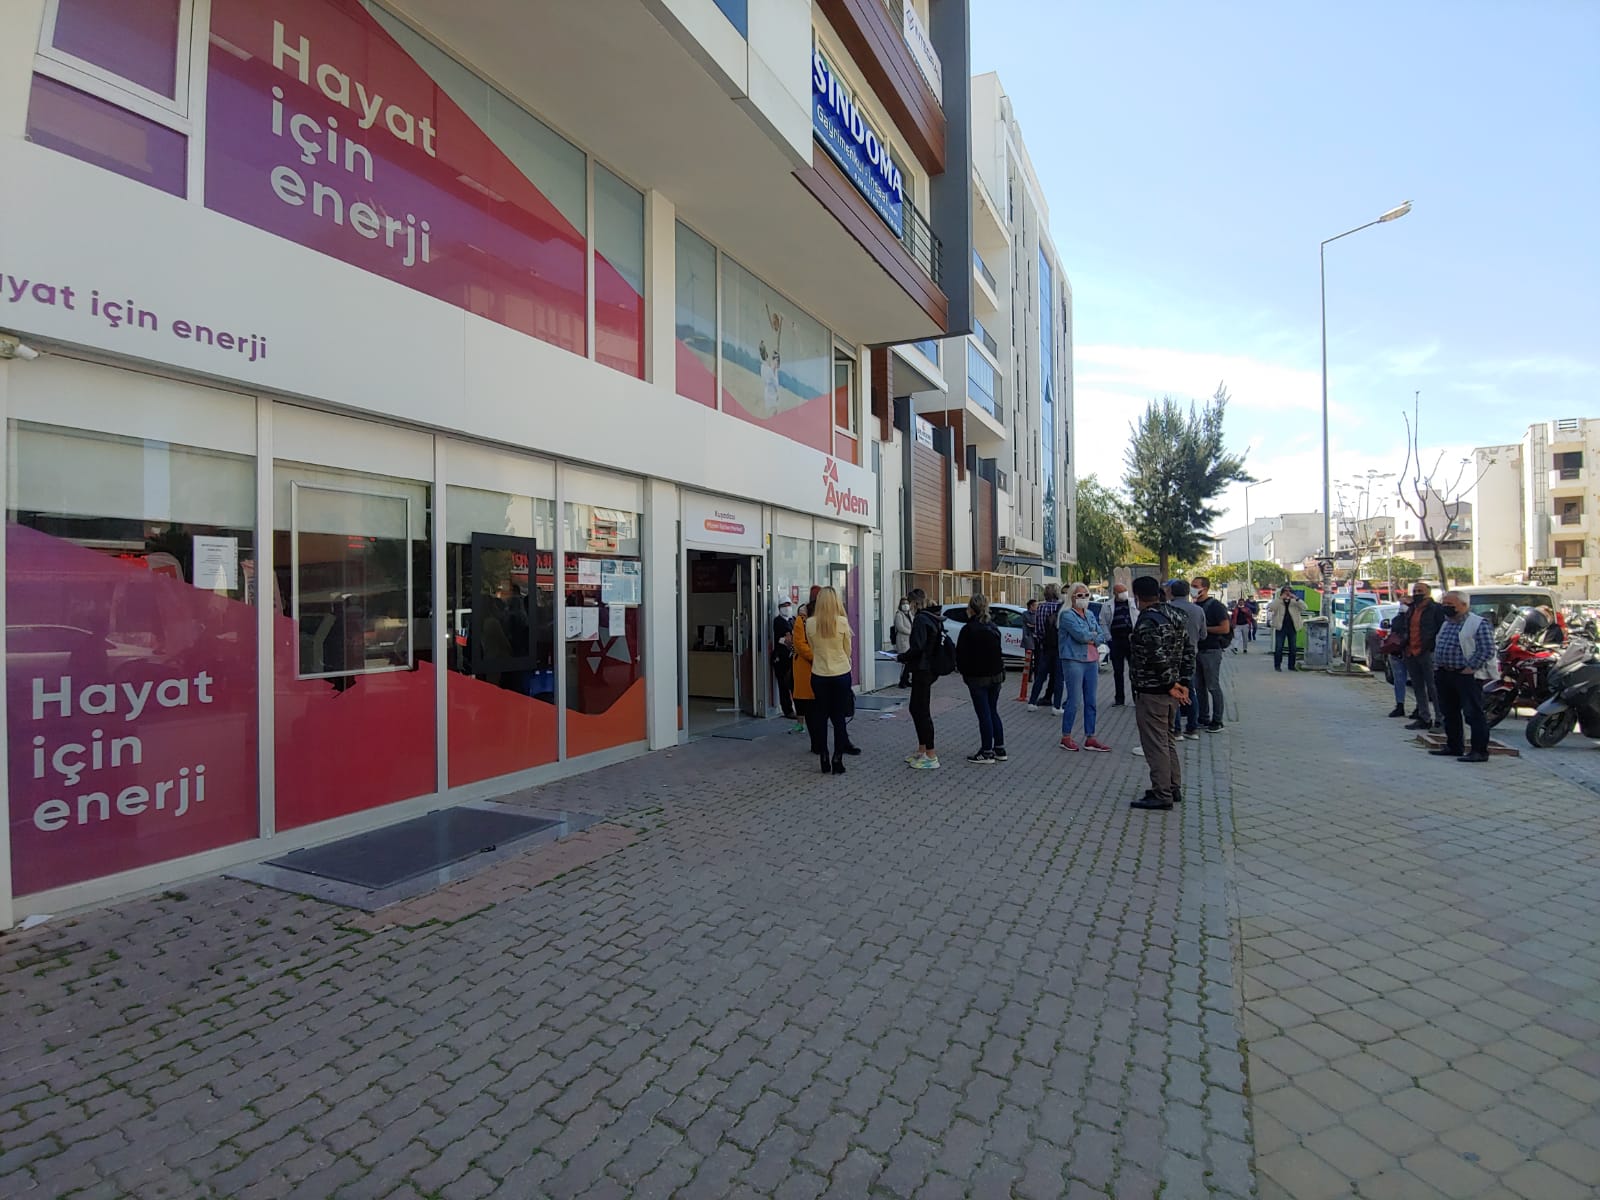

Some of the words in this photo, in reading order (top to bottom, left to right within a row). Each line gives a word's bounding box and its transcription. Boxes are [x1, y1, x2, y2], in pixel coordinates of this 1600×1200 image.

[272, 20, 436, 158] Hayat
[272, 86, 374, 182] için
[817, 103, 864, 174] Gayrimenkul
[270, 165, 430, 267] enerji
[91, 290, 158, 331] için
[172, 319, 267, 362] enerji
[825, 481, 868, 516] Aydem
[32, 670, 213, 721] Hayat
[33, 728, 142, 786] için
[33, 764, 206, 832] enerji
